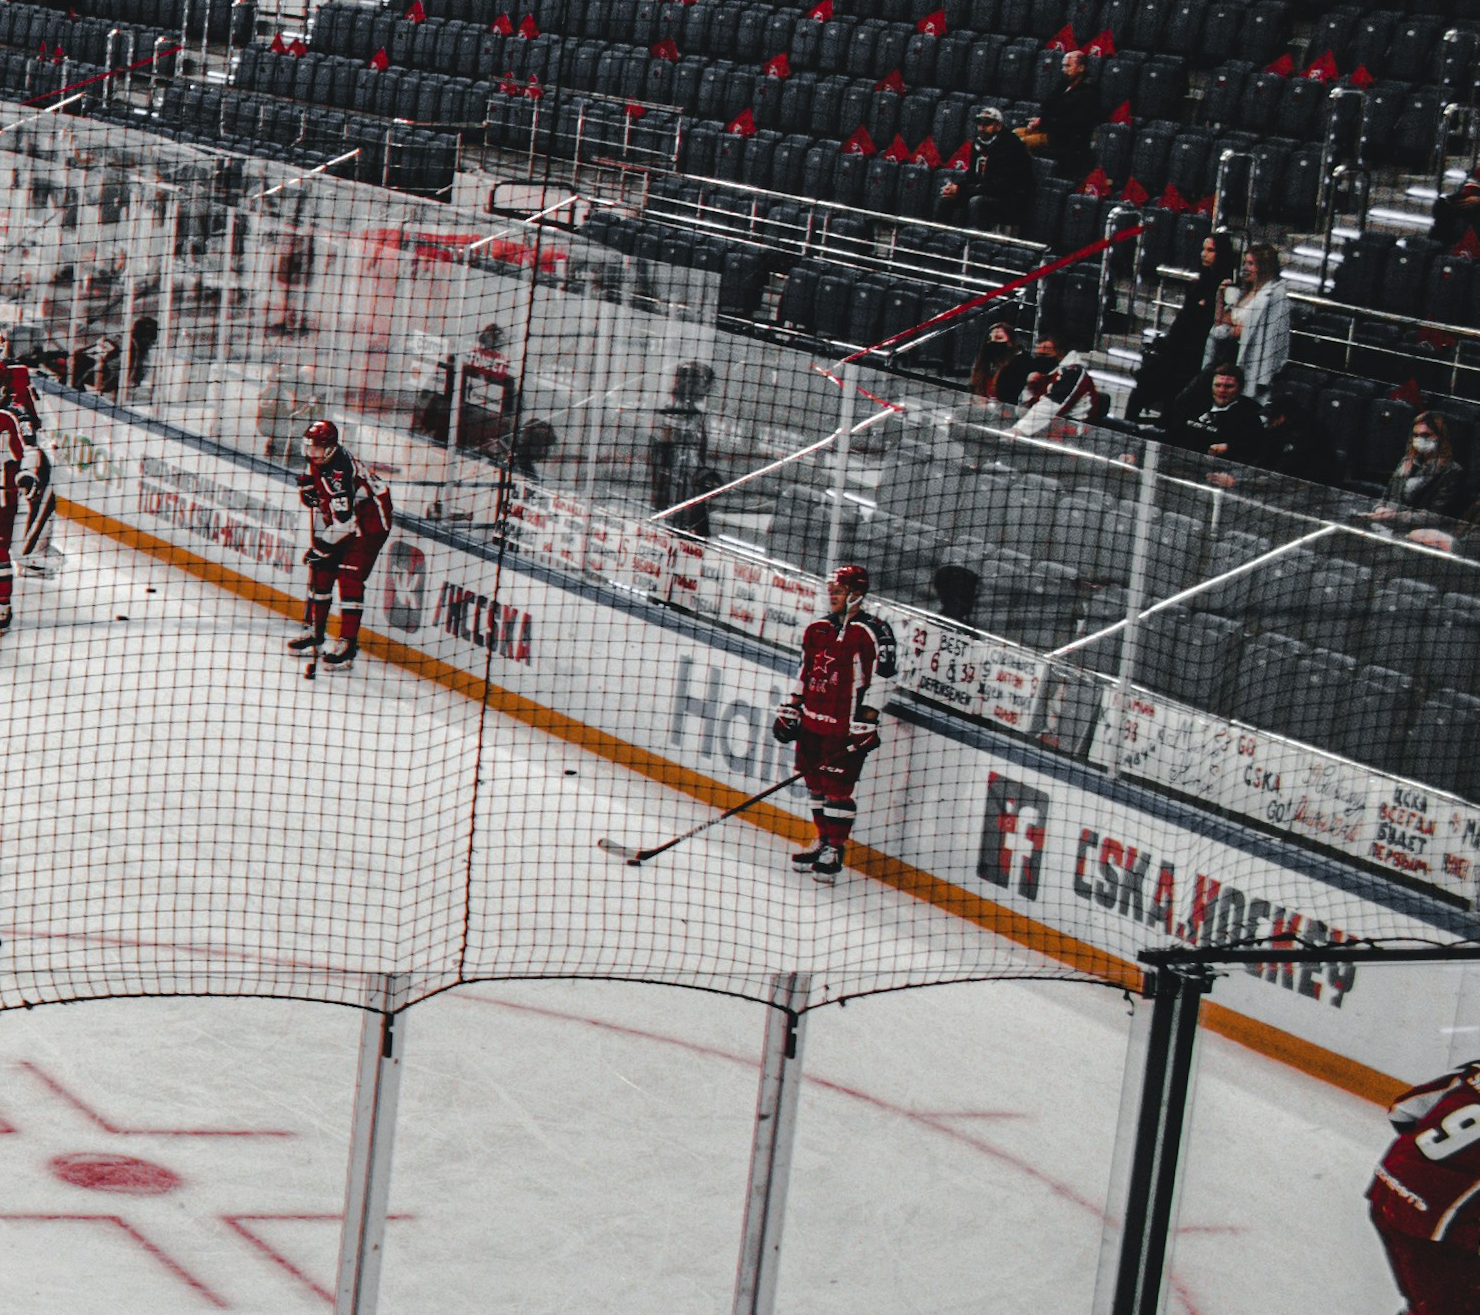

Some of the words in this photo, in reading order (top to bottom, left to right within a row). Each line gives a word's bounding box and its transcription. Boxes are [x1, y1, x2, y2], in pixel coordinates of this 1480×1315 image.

[913, 627, 928, 646] 23
[939, 632, 969, 657] BEST
[920, 674, 973, 707] DEFENSEMEN
[1244, 764, 1281, 793] CSKA
[1394, 788, 1428, 813] ЦСКА
[1380, 802, 1436, 837] ВСЕГДА
[1375, 825, 1428, 855] БУДЕТ
